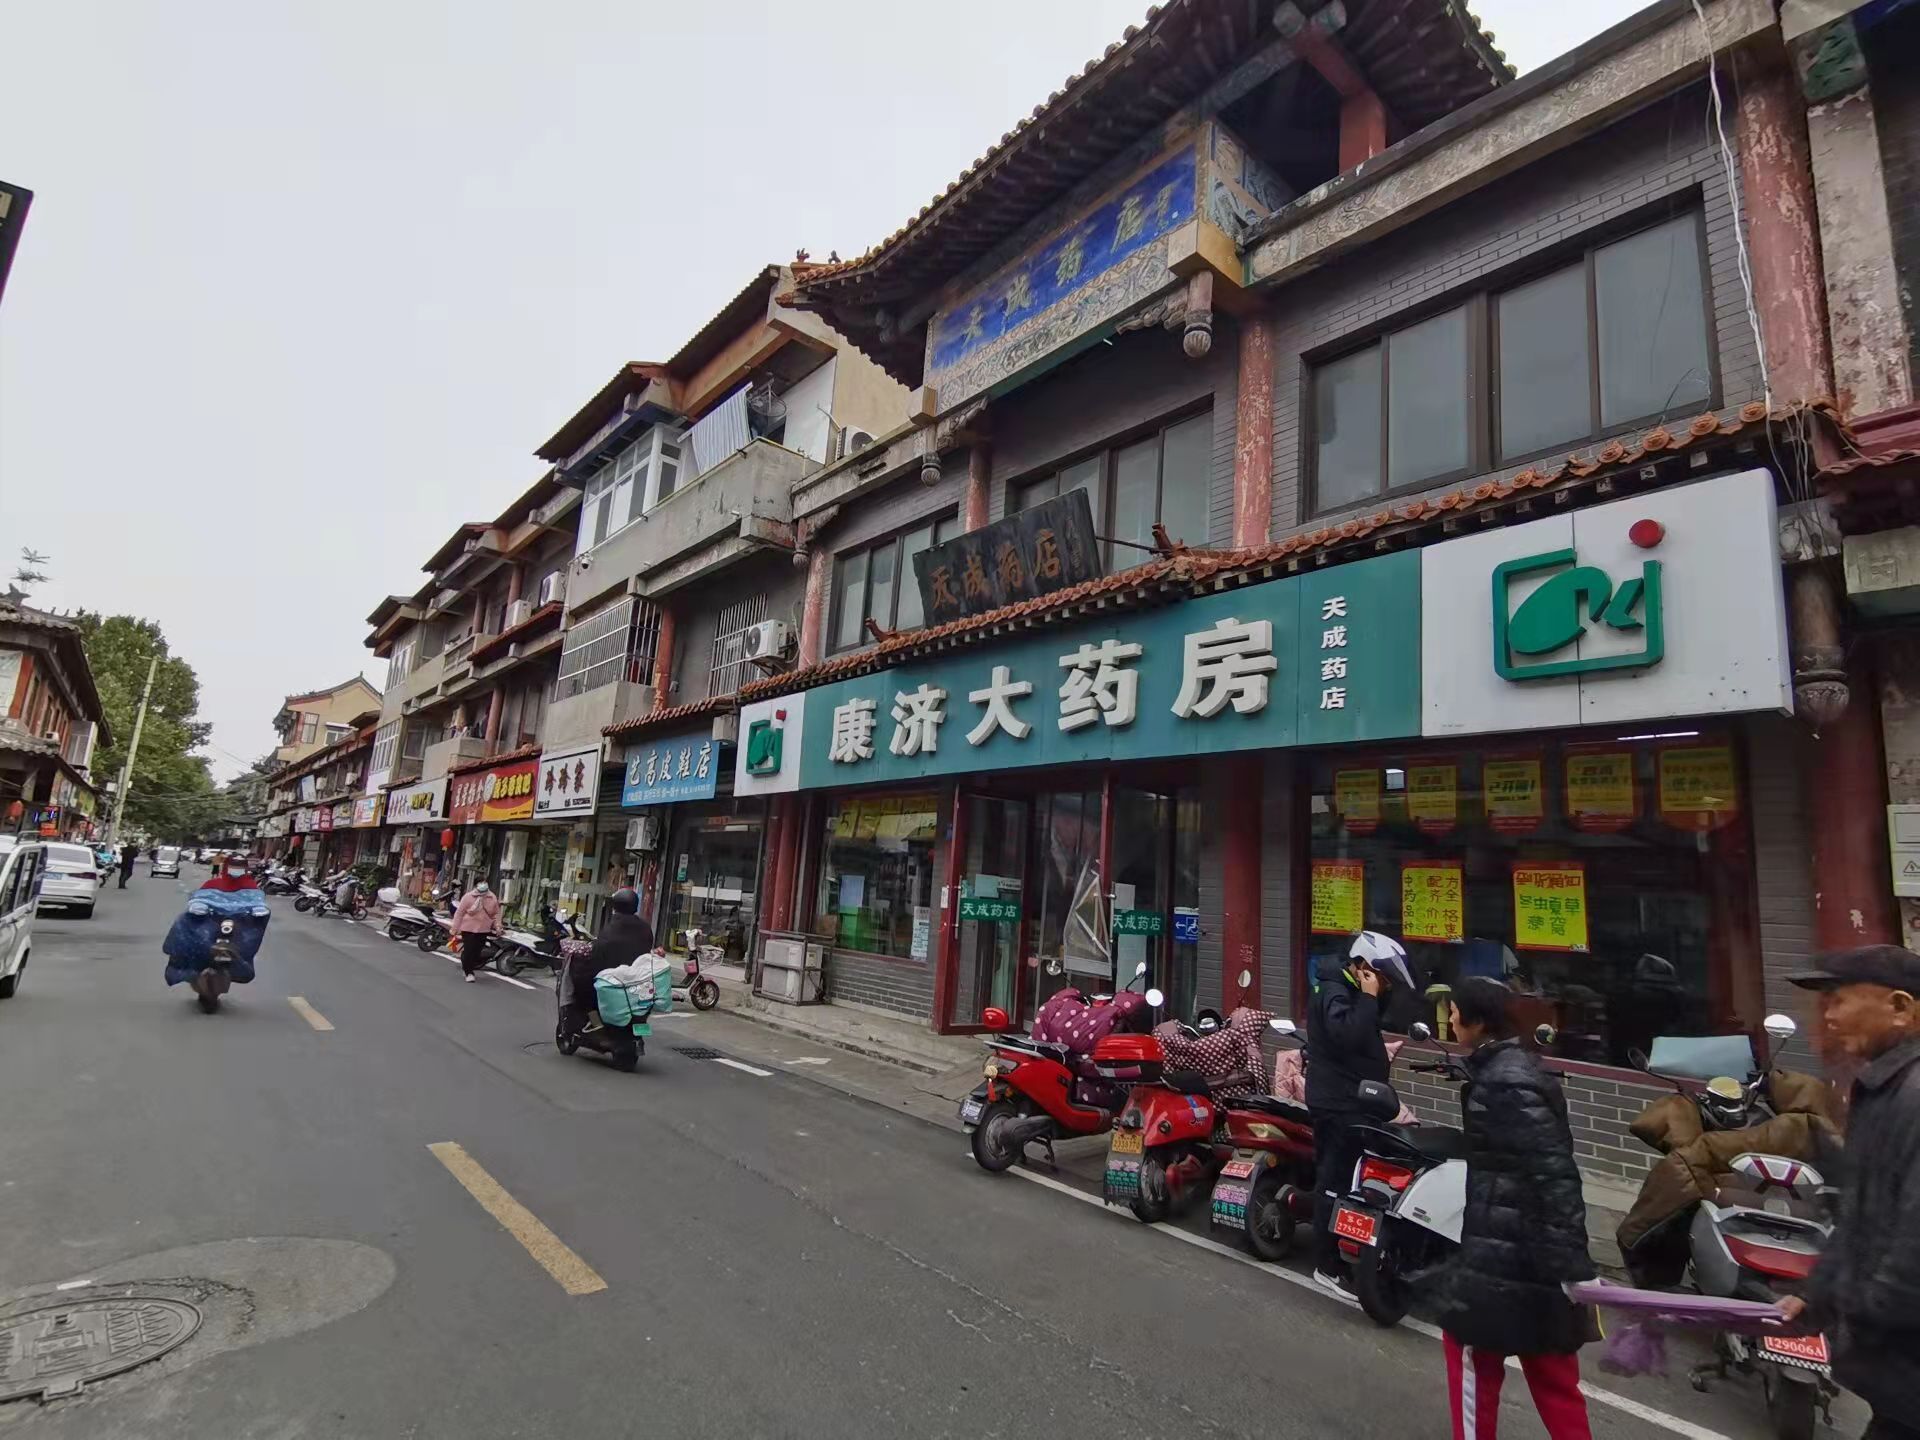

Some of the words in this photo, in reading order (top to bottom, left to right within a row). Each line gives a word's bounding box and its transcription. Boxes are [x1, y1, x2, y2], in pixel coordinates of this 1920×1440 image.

[1319, 596, 1348, 710] 天成药店
[827, 617, 1278, 763] 康济大药房
[961, 902, 1017, 918] 天成药店
[1113, 914, 1161, 931] 天成药店
